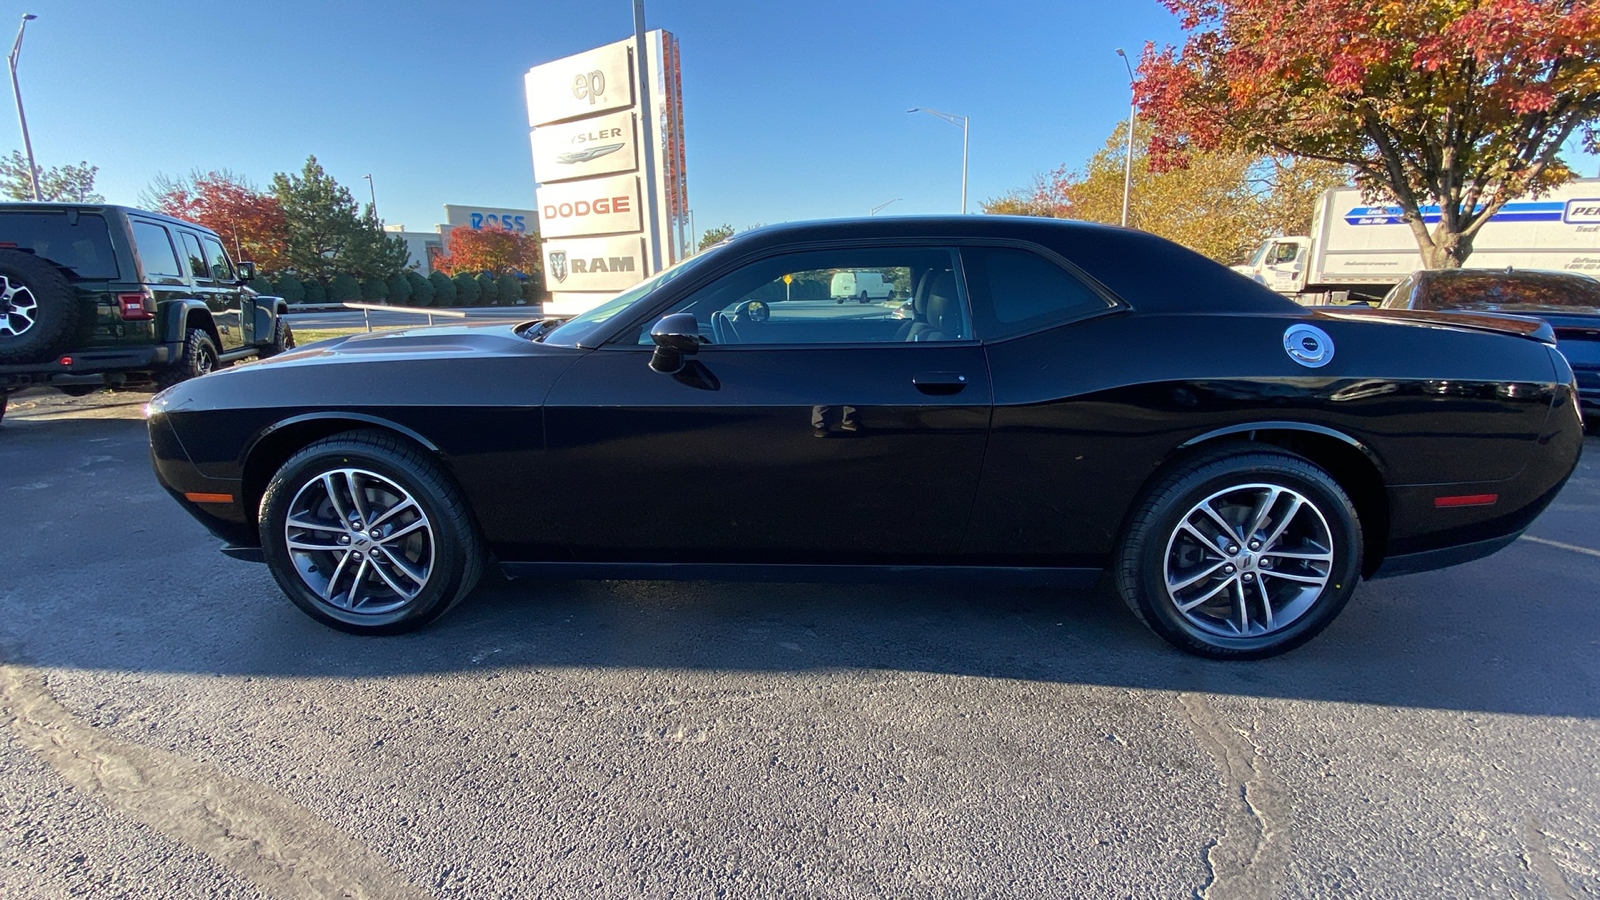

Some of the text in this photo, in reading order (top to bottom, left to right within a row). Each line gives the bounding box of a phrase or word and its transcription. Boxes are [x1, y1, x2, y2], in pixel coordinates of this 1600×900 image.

[572, 69, 605, 105] ep
[570, 127, 622, 144] YSLER
[544, 196, 630, 219] DODGE
[470, 213, 525, 232] ROSS
[571, 256, 635, 273] RAM
